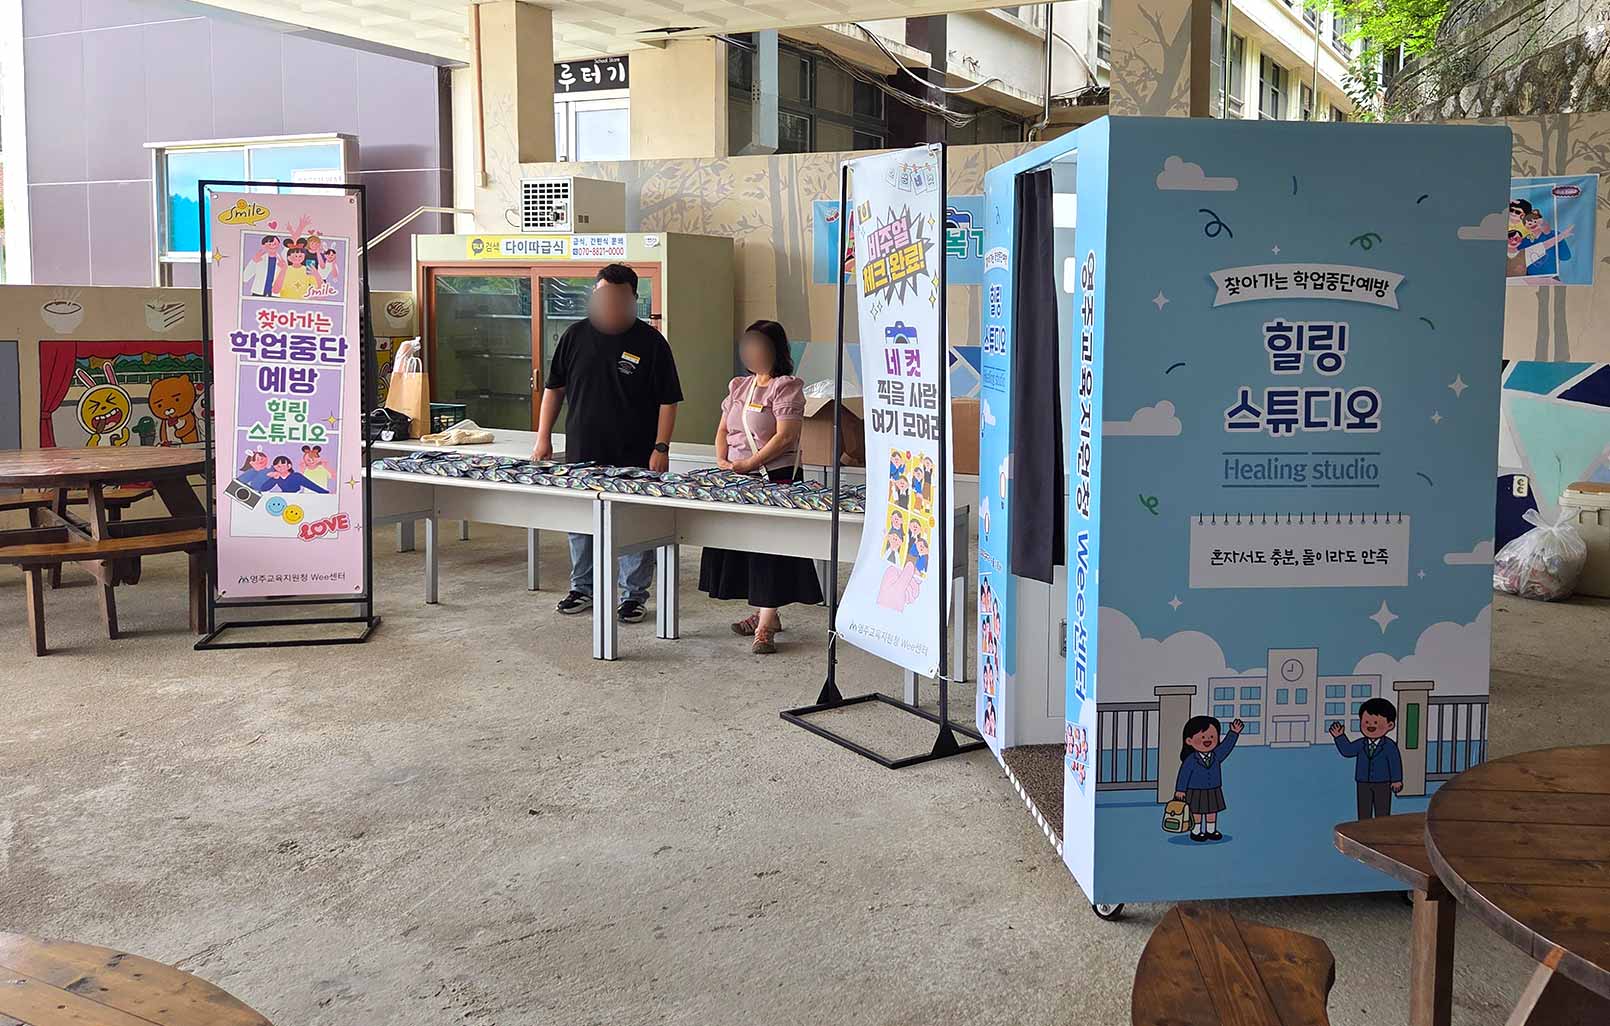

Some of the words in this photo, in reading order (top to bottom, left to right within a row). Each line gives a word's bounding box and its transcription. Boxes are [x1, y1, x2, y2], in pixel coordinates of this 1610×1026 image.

[485, 241, 500, 253] 검색
[505, 239, 564, 255] 다이따급식
[867, 216, 911, 261] 비주얼
[863, 258, 888, 294] 체크
[889, 240, 926, 281] 완료!
[1224, 270, 1288, 296] 찾아가는
[1293, 270, 1390, 298] 학업중단예방
[257, 309, 332, 333] 찾아가는
[229, 331, 349, 364] 학업중단
[1264, 319, 1348, 376] 힐링
[885, 348, 900, 375] 네
[904, 349, 921, 377] 컷
[258, 366, 318, 394] 예방
[1076, 251, 1095, 518] 영주교육지원청
[877, 380, 905, 406] 찍을
[910, 381, 937, 410] 사람
[267, 398, 309, 423] 힐링
[871, 408, 899, 435] 여기
[1225, 388, 1381, 436] 스튜디오
[248, 424, 327, 443] 스튜디오
[1224, 458, 1308, 482] Healing
[1312, 457, 1379, 480] studio
[299, 513, 350, 541] LOVE
[1210, 549, 1267, 566] 혼자서도
[1270, 549, 1299, 566] 충분,
[1302, 548, 1358, 566] 둘이라도
[1361, 547, 1389, 566] 만족
[250, 573, 308, 585] 영주교육지원청
[310, 570, 346, 583] Wee센터
[1074, 531, 1090, 702] Wee센터
